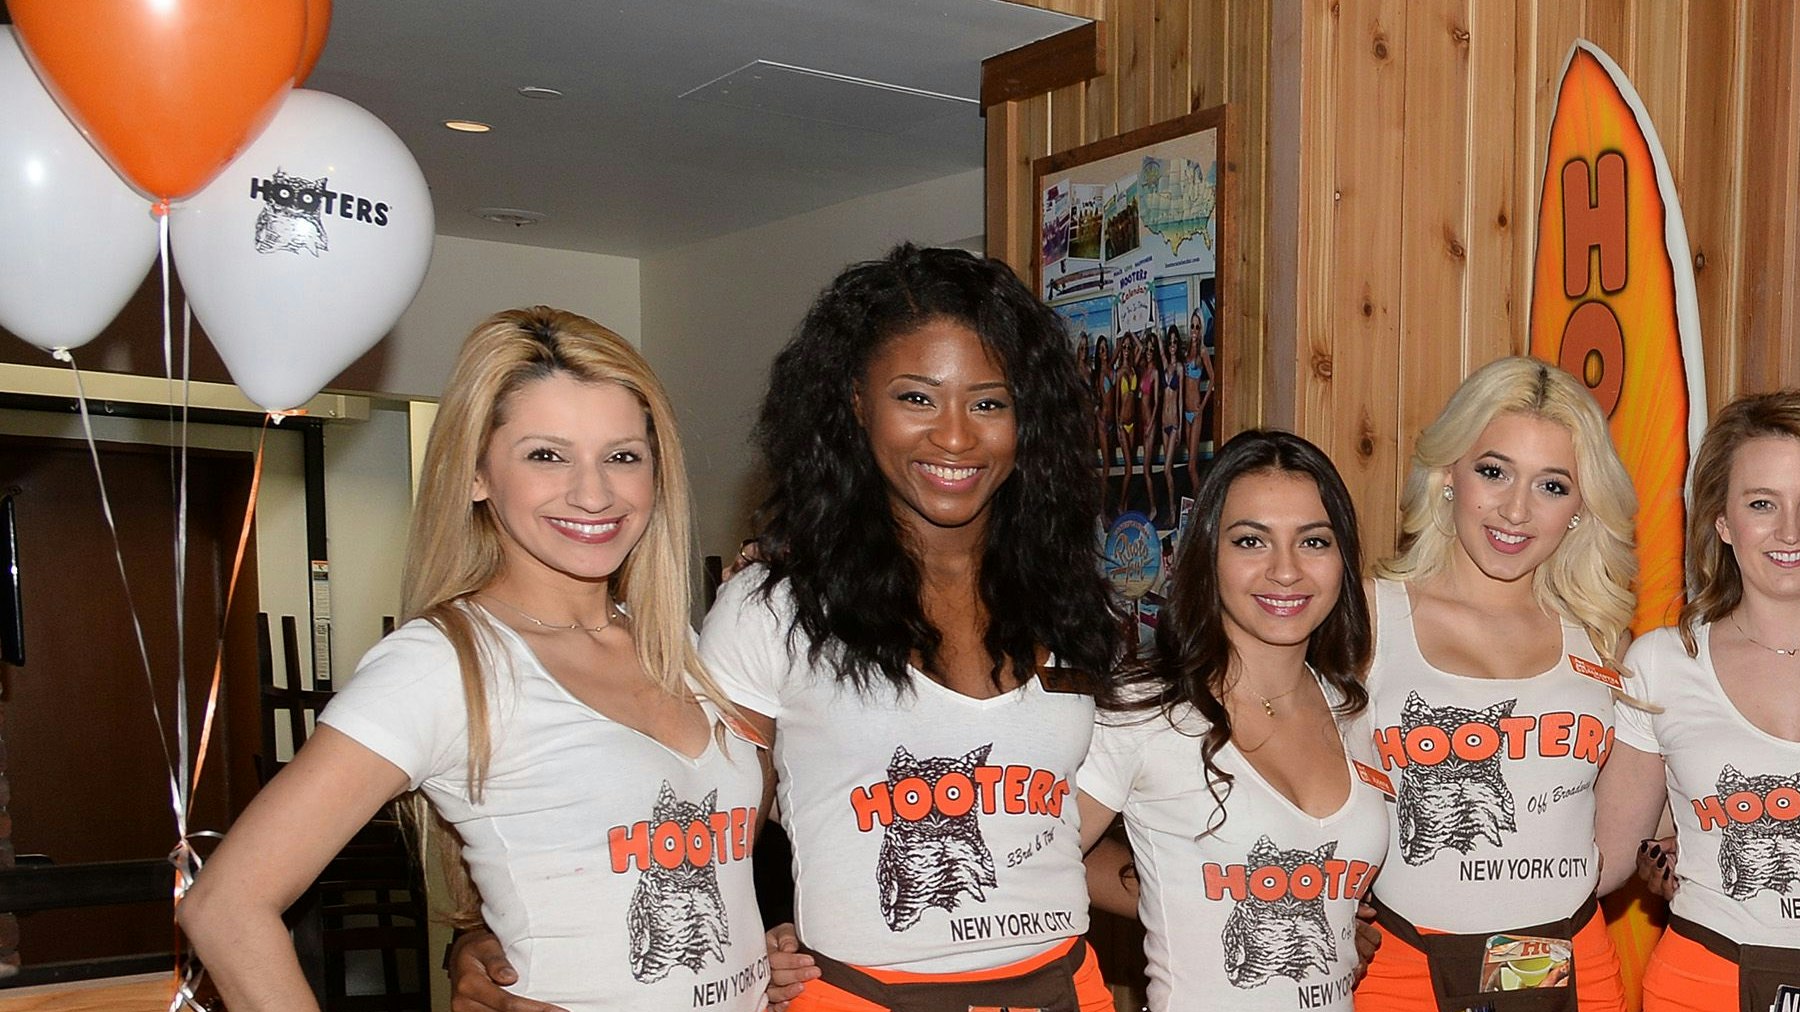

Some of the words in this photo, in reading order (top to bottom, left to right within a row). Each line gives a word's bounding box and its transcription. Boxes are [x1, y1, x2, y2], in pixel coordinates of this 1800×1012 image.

[250, 177, 389, 227] HOOTERS
[1120, 269, 1148, 289] HOOTERS
[850, 765, 1070, 832] HOOTERS
[1528, 792, 1547, 815] Off
[1460, 859, 1501, 882] NEW
[1507, 858, 1552, 880] YORK
[1558, 857, 1588, 878] CITY
[950, 916, 992, 941] NEW
[995, 913, 1048, 937] YORK
[1045, 911, 1076, 932] CITY
[693, 979, 728, 1007] NEW
[731, 963, 756, 997] YORK
[1298, 982, 1333, 1009] NEW
